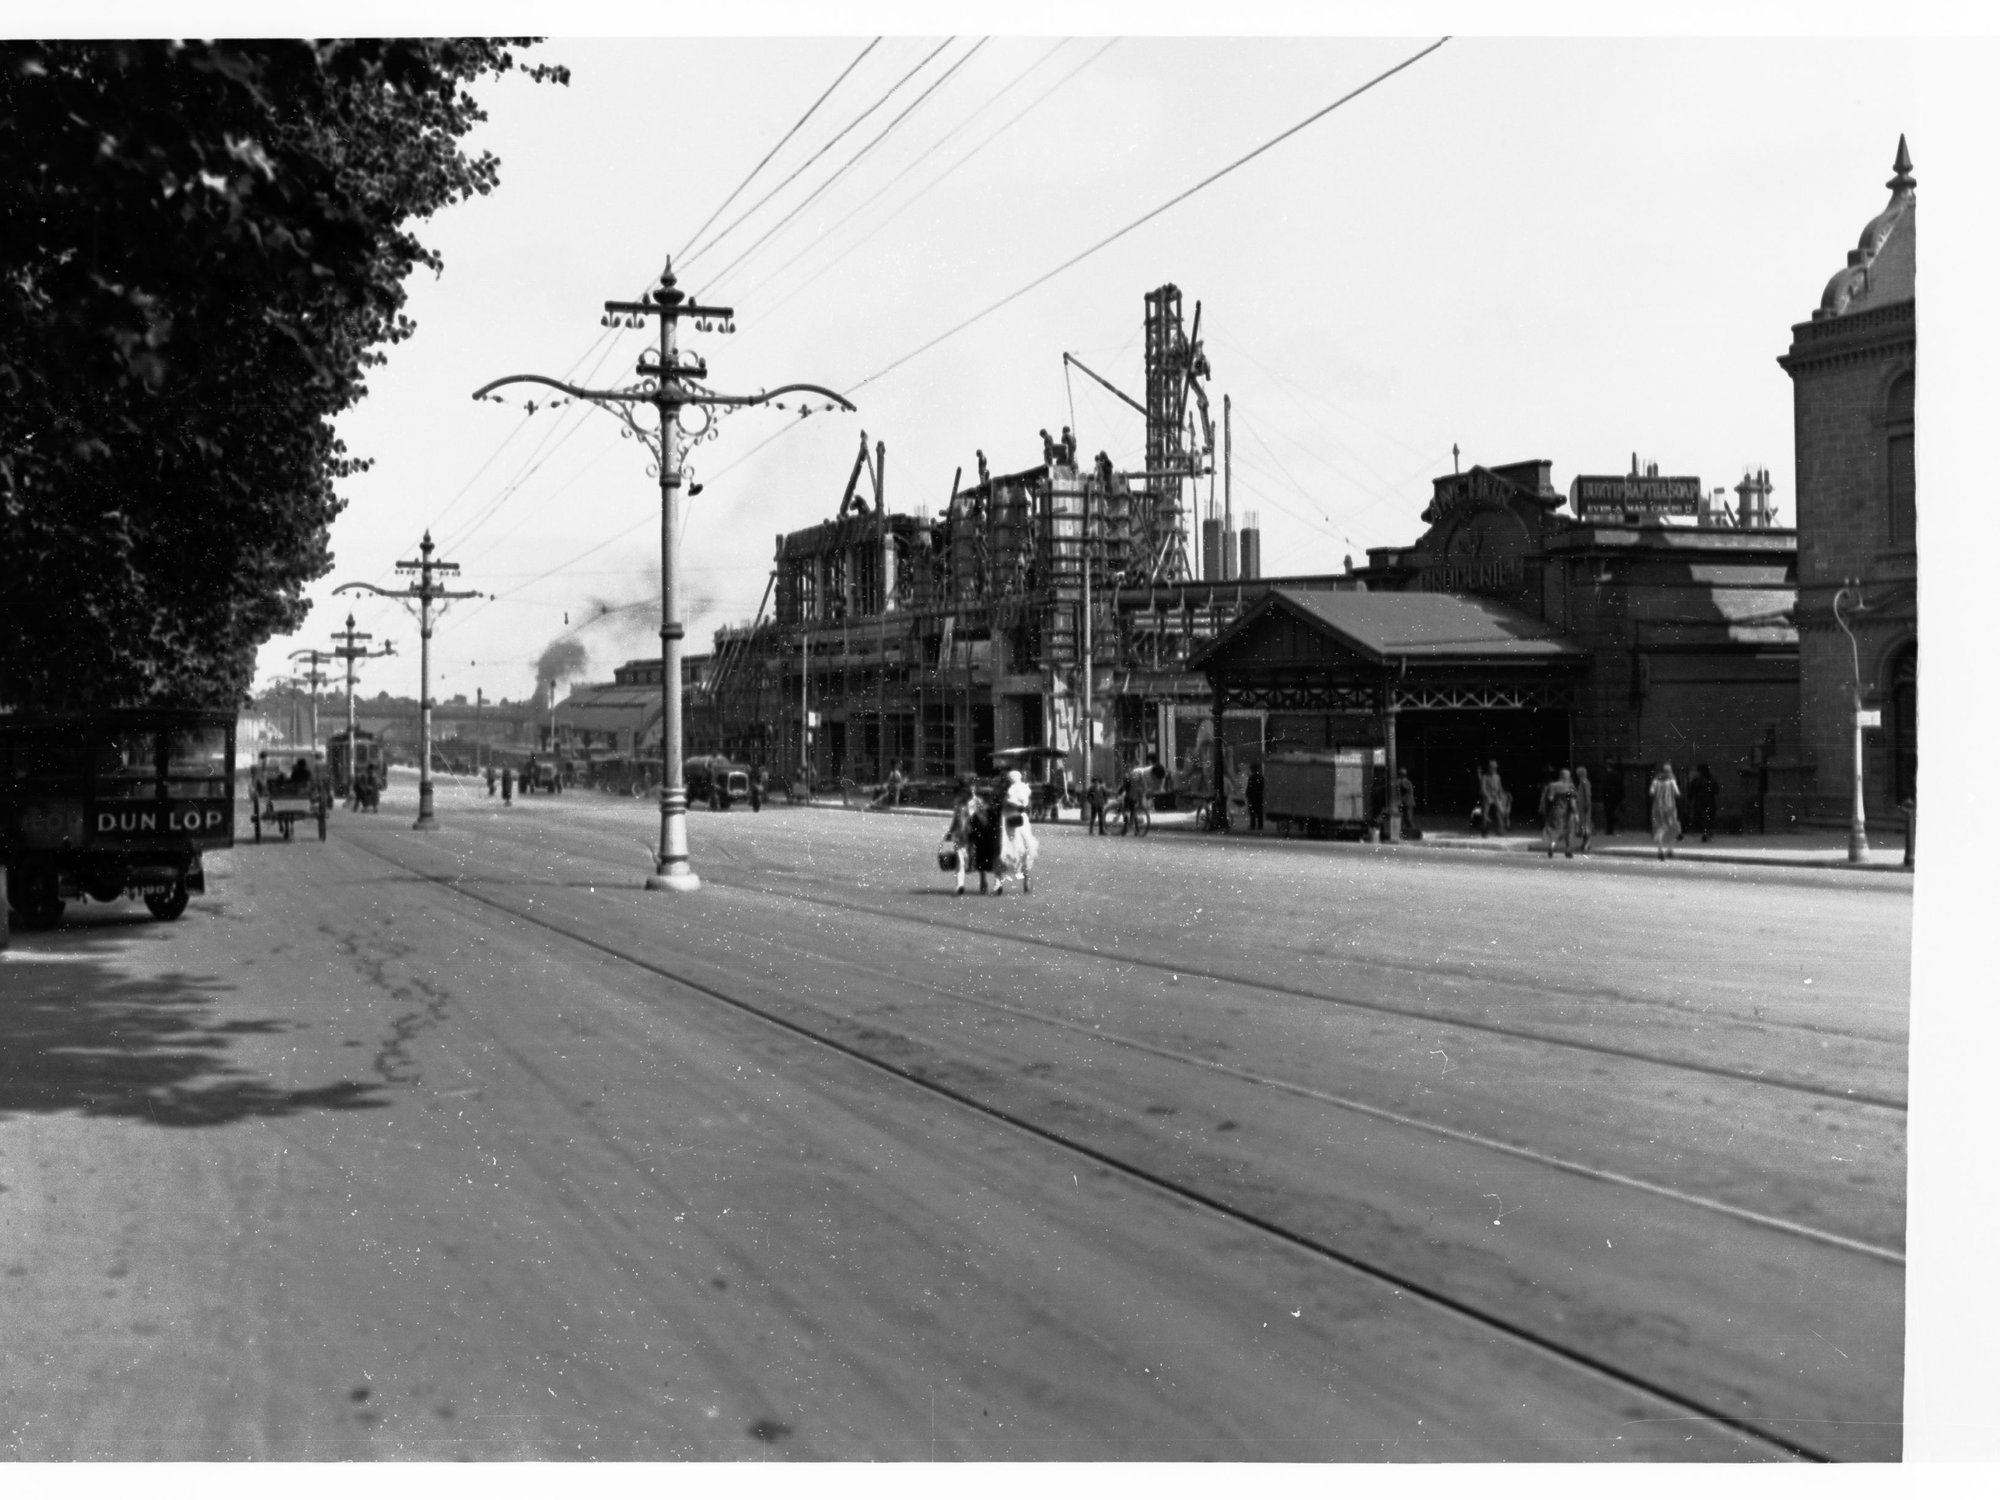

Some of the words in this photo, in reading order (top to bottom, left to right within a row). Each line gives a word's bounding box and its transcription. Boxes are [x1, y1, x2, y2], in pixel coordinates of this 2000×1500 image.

[1670, 482, 1698, 498] SOAP
[1627, 504, 1647, 512] MAN
[1651, 504, 1668, 513] CAN
